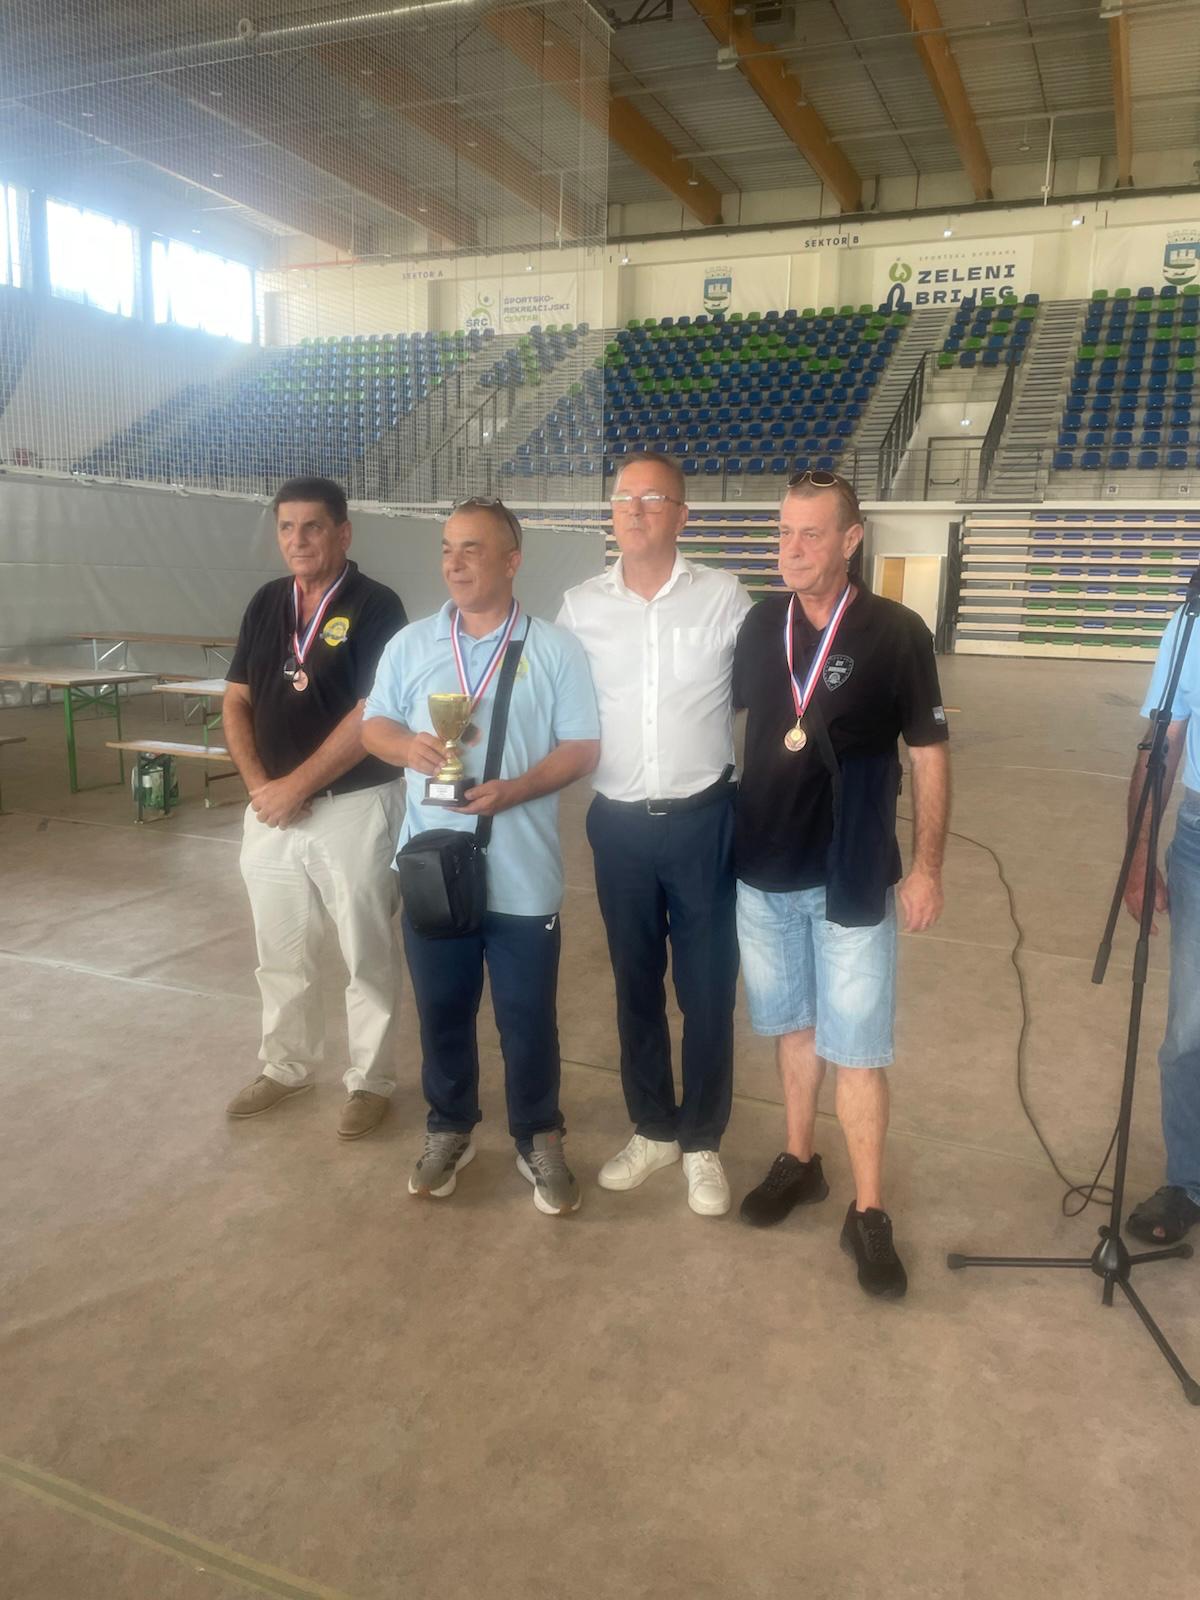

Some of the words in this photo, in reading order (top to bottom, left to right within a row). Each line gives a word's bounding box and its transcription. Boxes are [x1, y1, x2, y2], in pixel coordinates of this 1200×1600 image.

[805, 237, 848, 248] SEKTOR
[852, 235, 859, 244] B
[917, 264, 1015, 284] ZELENI
[915, 285, 1015, 305] BRIJEG
[465, 318, 489, 328] SRC
